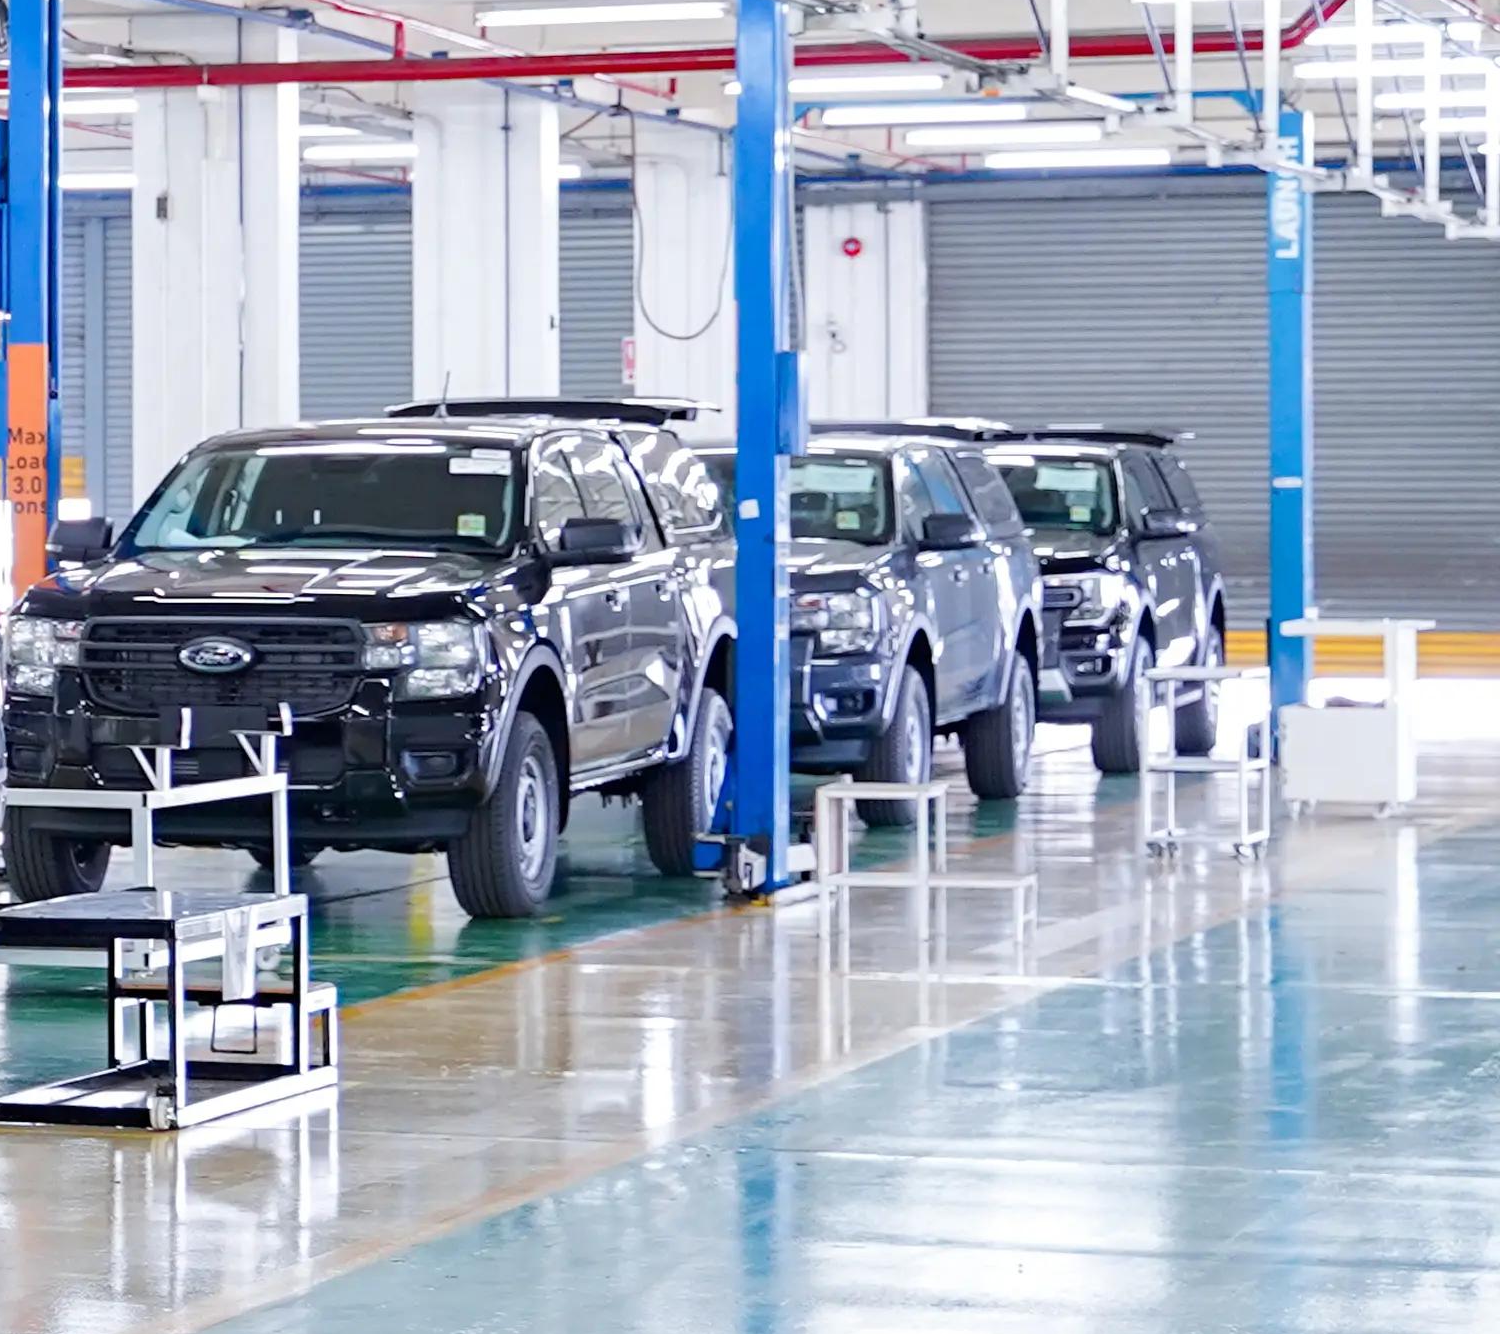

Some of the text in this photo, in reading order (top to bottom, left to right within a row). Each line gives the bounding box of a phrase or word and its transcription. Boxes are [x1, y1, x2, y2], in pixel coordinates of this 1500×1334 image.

[8, 427, 46, 445] Max
[8, 456, 47, 470] oa
[13, 475, 43, 495] 3.0
